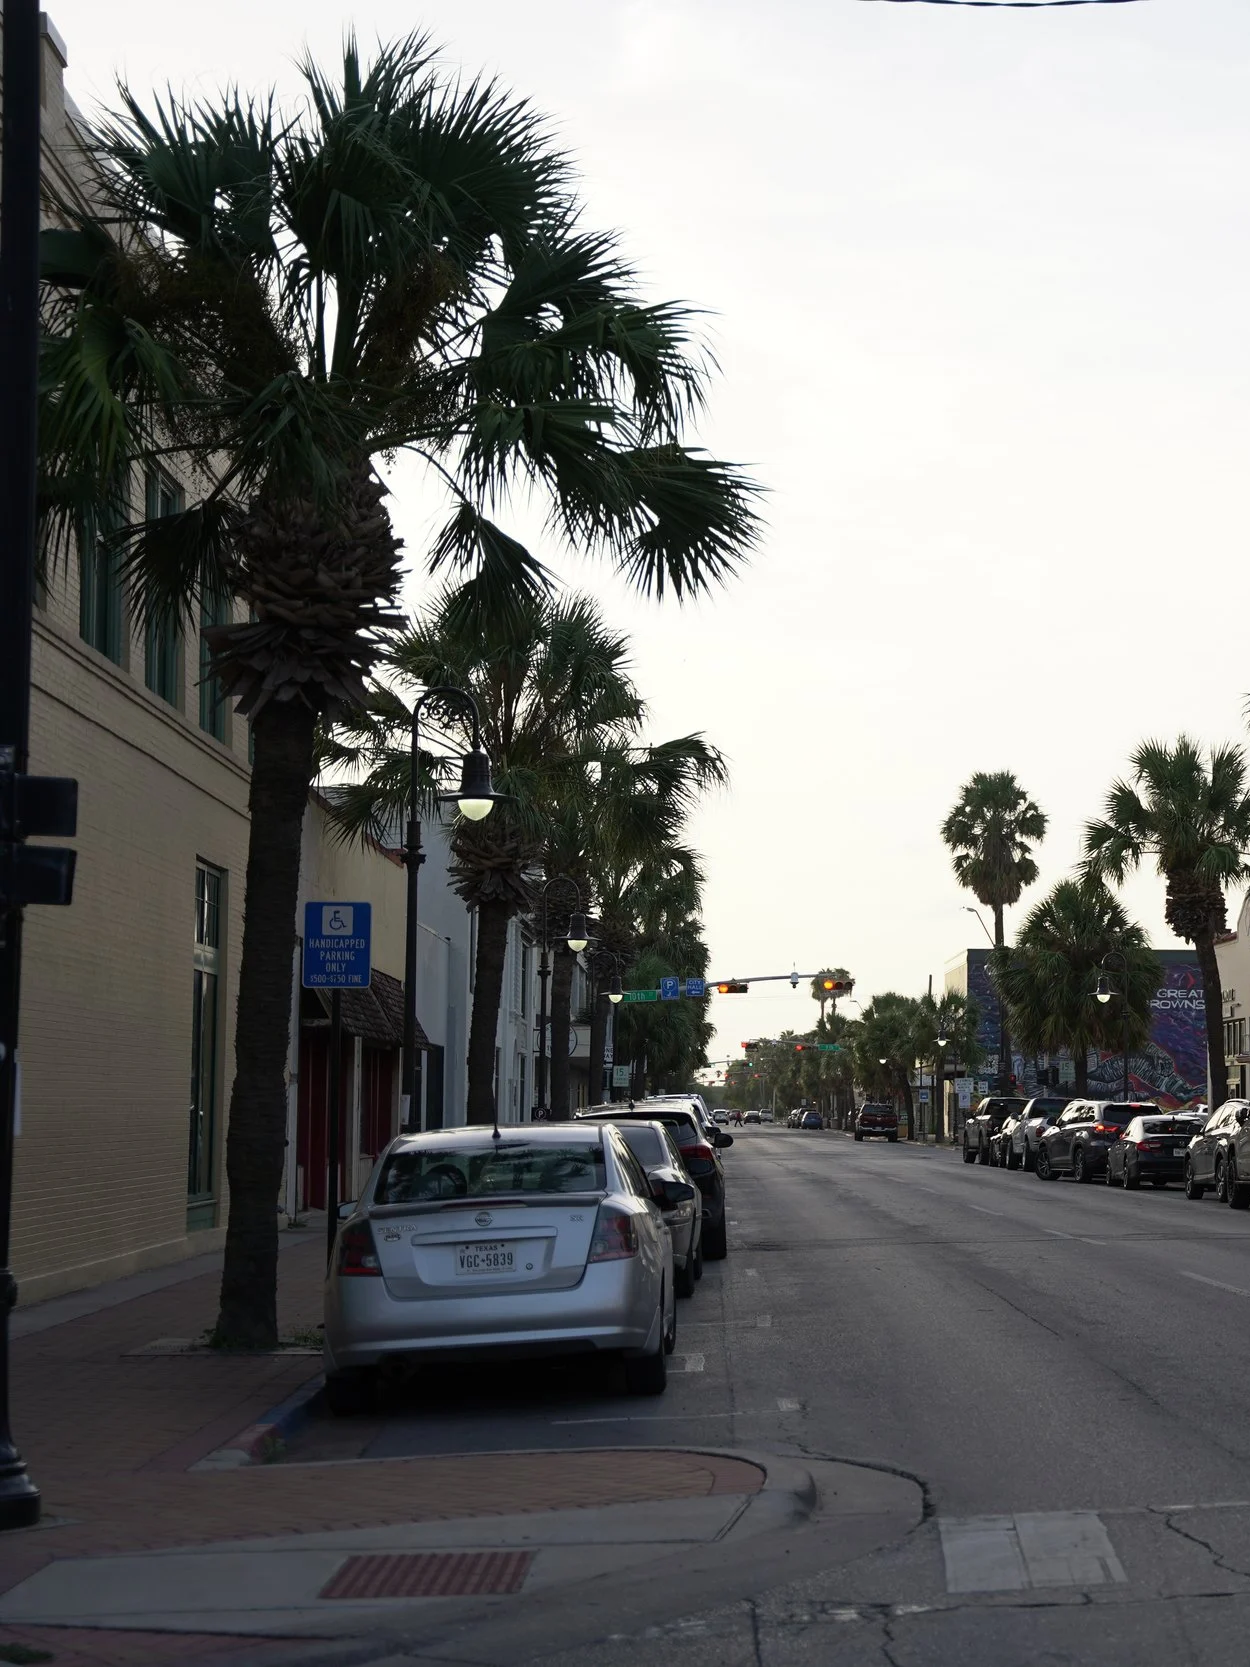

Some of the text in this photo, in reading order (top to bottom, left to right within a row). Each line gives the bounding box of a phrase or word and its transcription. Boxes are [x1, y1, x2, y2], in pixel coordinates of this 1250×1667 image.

[309, 938, 365, 949] HANDICAPPED
[320, 951, 355, 960] PARKING
[325, 962, 346, 972] ONLY
[348, 974, 362, 983] FINE
[629, 993, 646, 1001] 10th
[1149, 999, 1206, 1010] ROWNS
[475, 1244, 498, 1252] TEXAS
